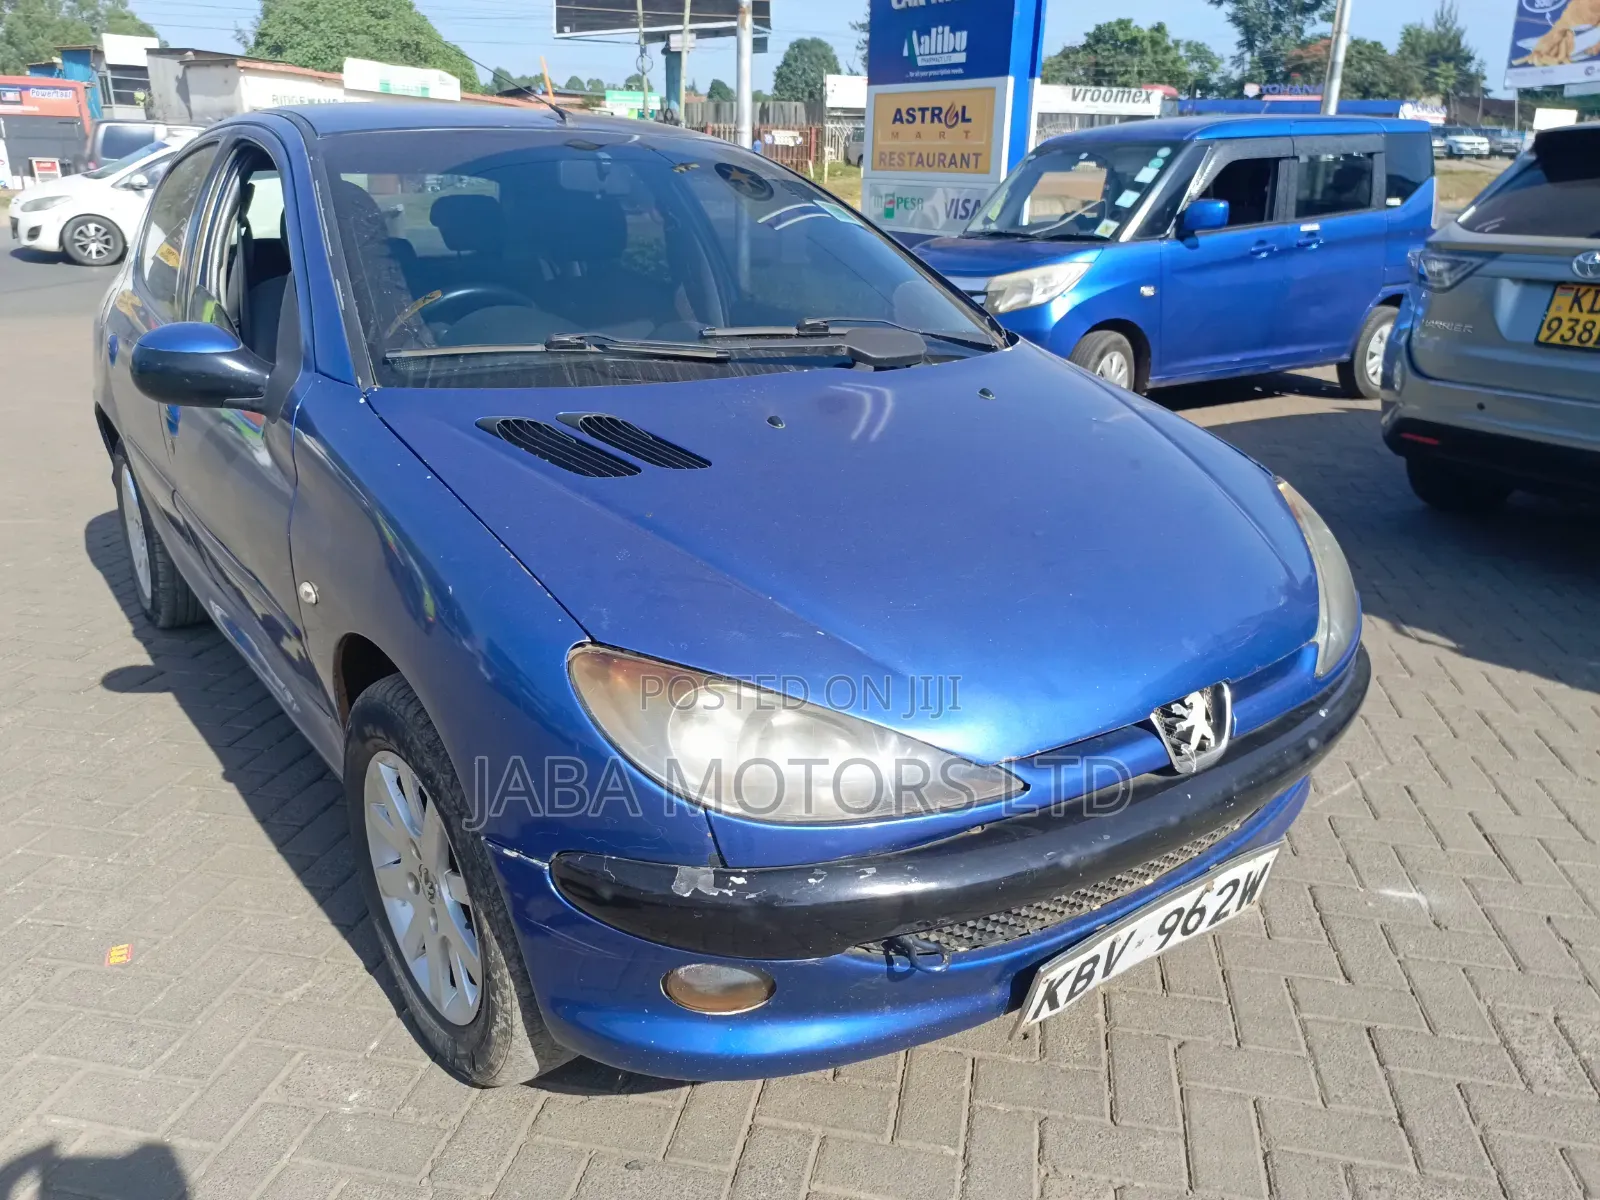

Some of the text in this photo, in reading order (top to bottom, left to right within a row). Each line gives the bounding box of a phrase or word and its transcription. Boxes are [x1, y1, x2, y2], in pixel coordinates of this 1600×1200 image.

[903, 25, 968, 57] Malibu
[1071, 87, 1154, 104] vroomex
[879, 151, 983, 170] RESTAURANT
[945, 197, 981, 220] VISA
[1545, 316, 1600, 345] 938
[1031, 862, 1269, 1020] KBV 962W
